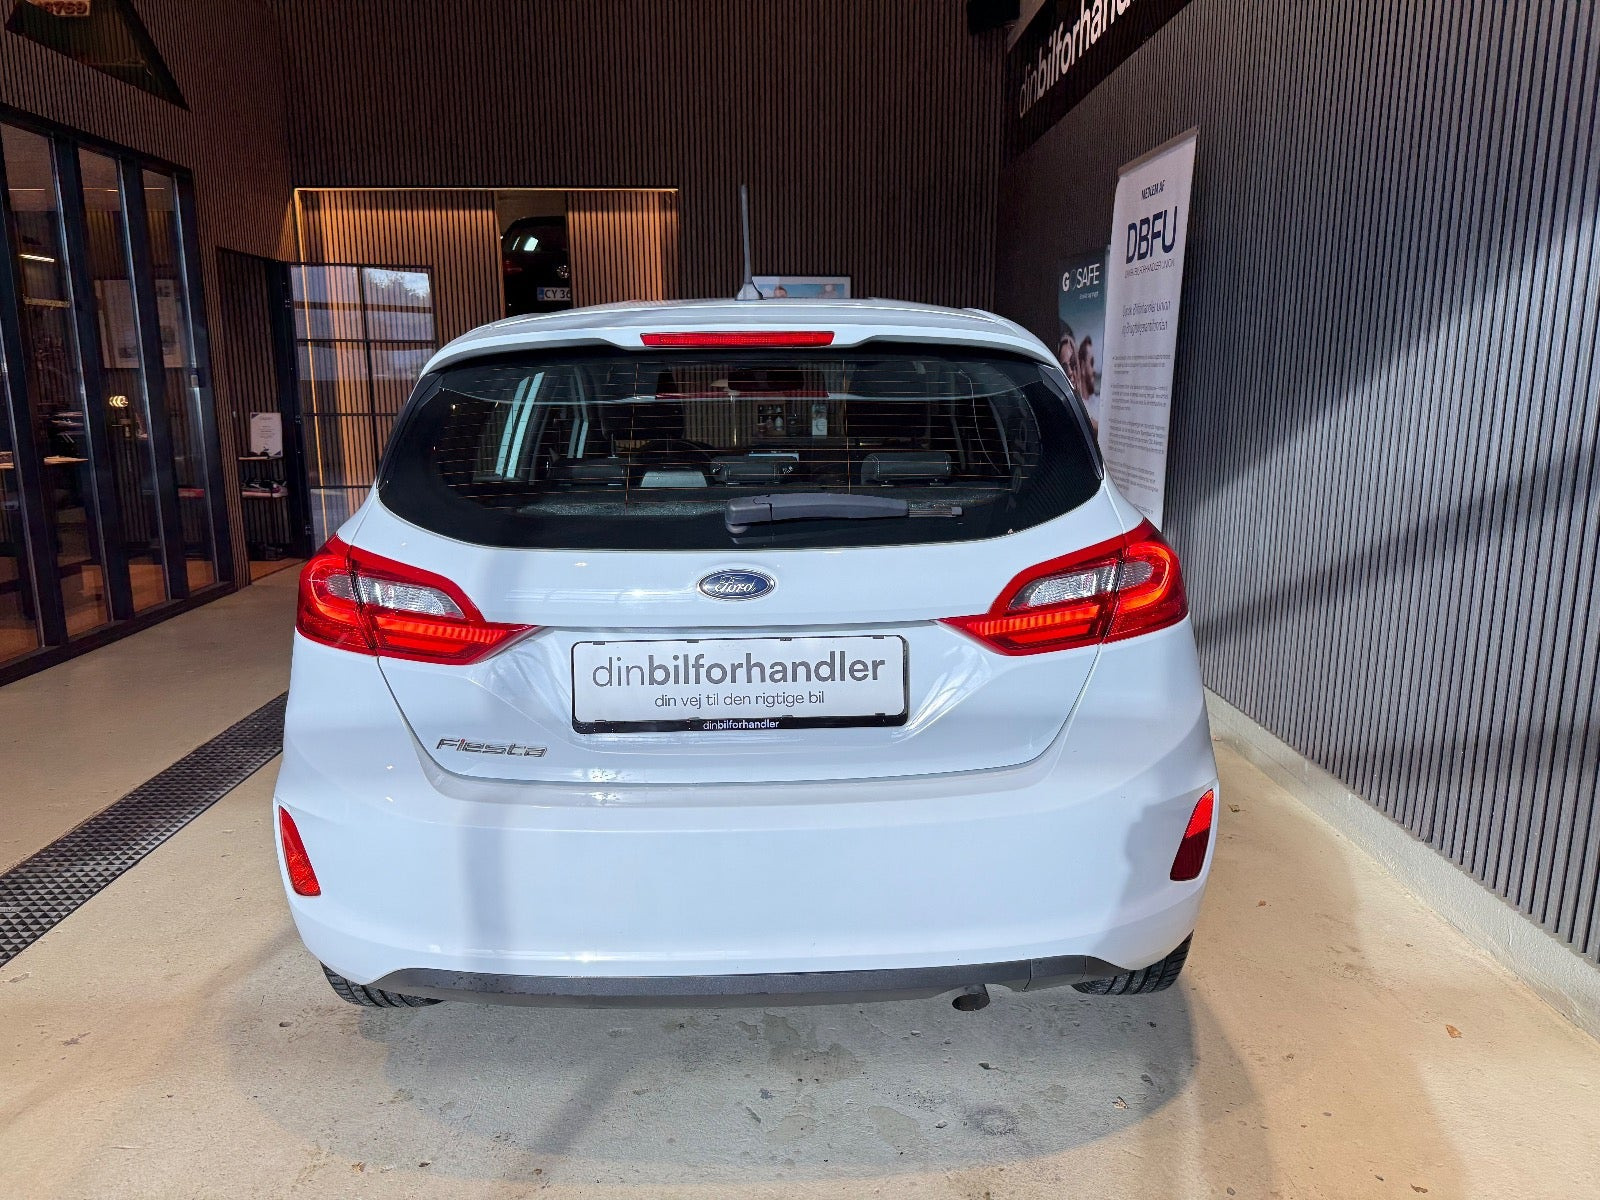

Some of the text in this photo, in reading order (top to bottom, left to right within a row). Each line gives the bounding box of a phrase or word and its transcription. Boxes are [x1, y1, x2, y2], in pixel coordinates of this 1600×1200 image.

[1126, 205, 1178, 265] DBFU
[544, 289, 557, 299] CY
[714, 575, 756, 593] Ford
[592, 651, 886, 687] dinbilforhandler
[654, 691, 825, 709] din vej til den rigtige bil
[703, 719, 780, 731] dinbilforhandler
[436, 738, 548, 757] Fiesta
